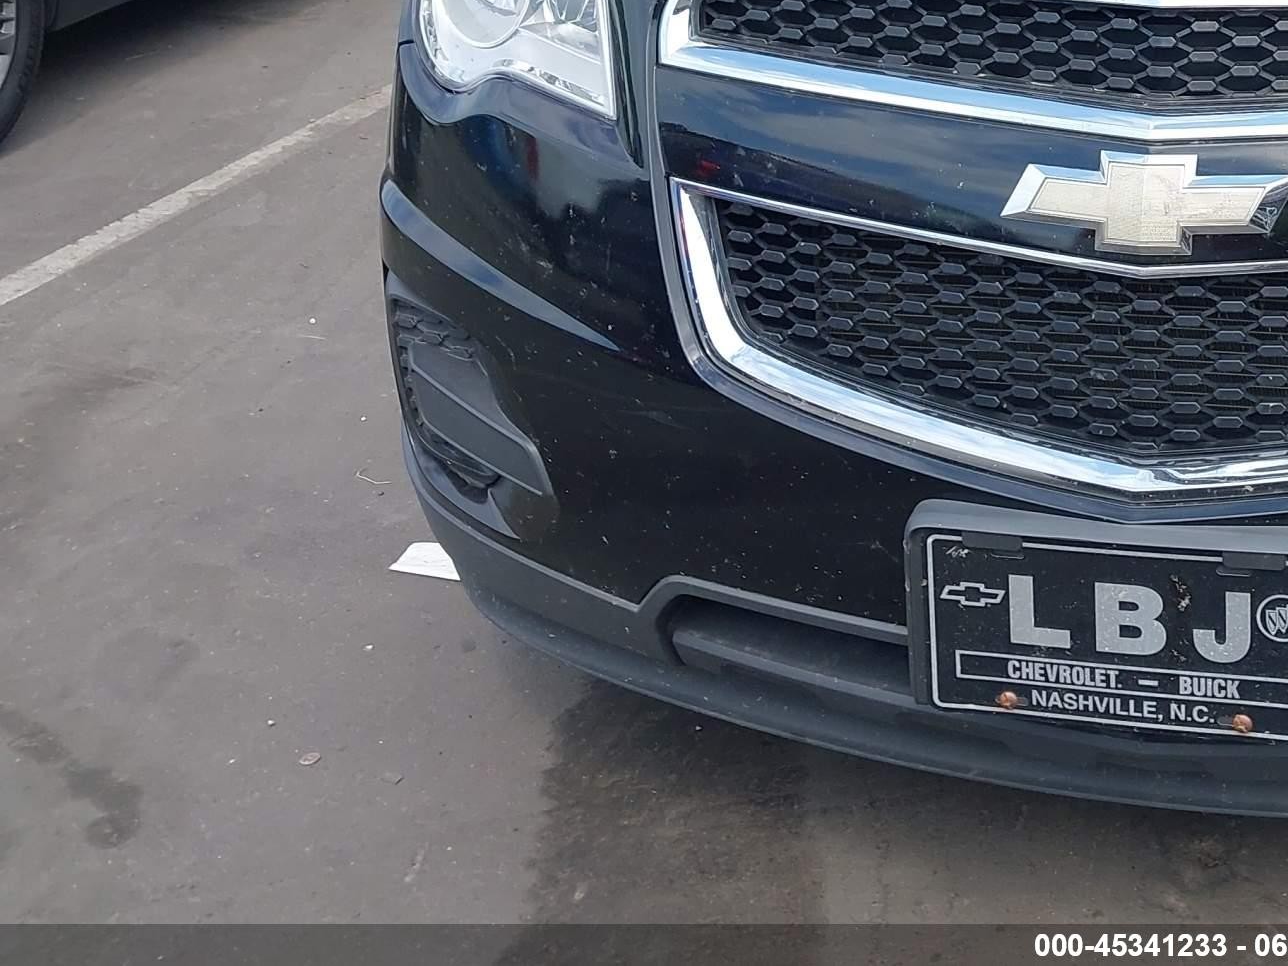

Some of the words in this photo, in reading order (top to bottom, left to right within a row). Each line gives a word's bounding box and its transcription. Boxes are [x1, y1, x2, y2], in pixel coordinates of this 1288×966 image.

[1179, 676, 1241, 699] BUICK
[1031, 689, 1163, 722] NASHVILLE,
[1170, 703, 1215, 723] N.C.
